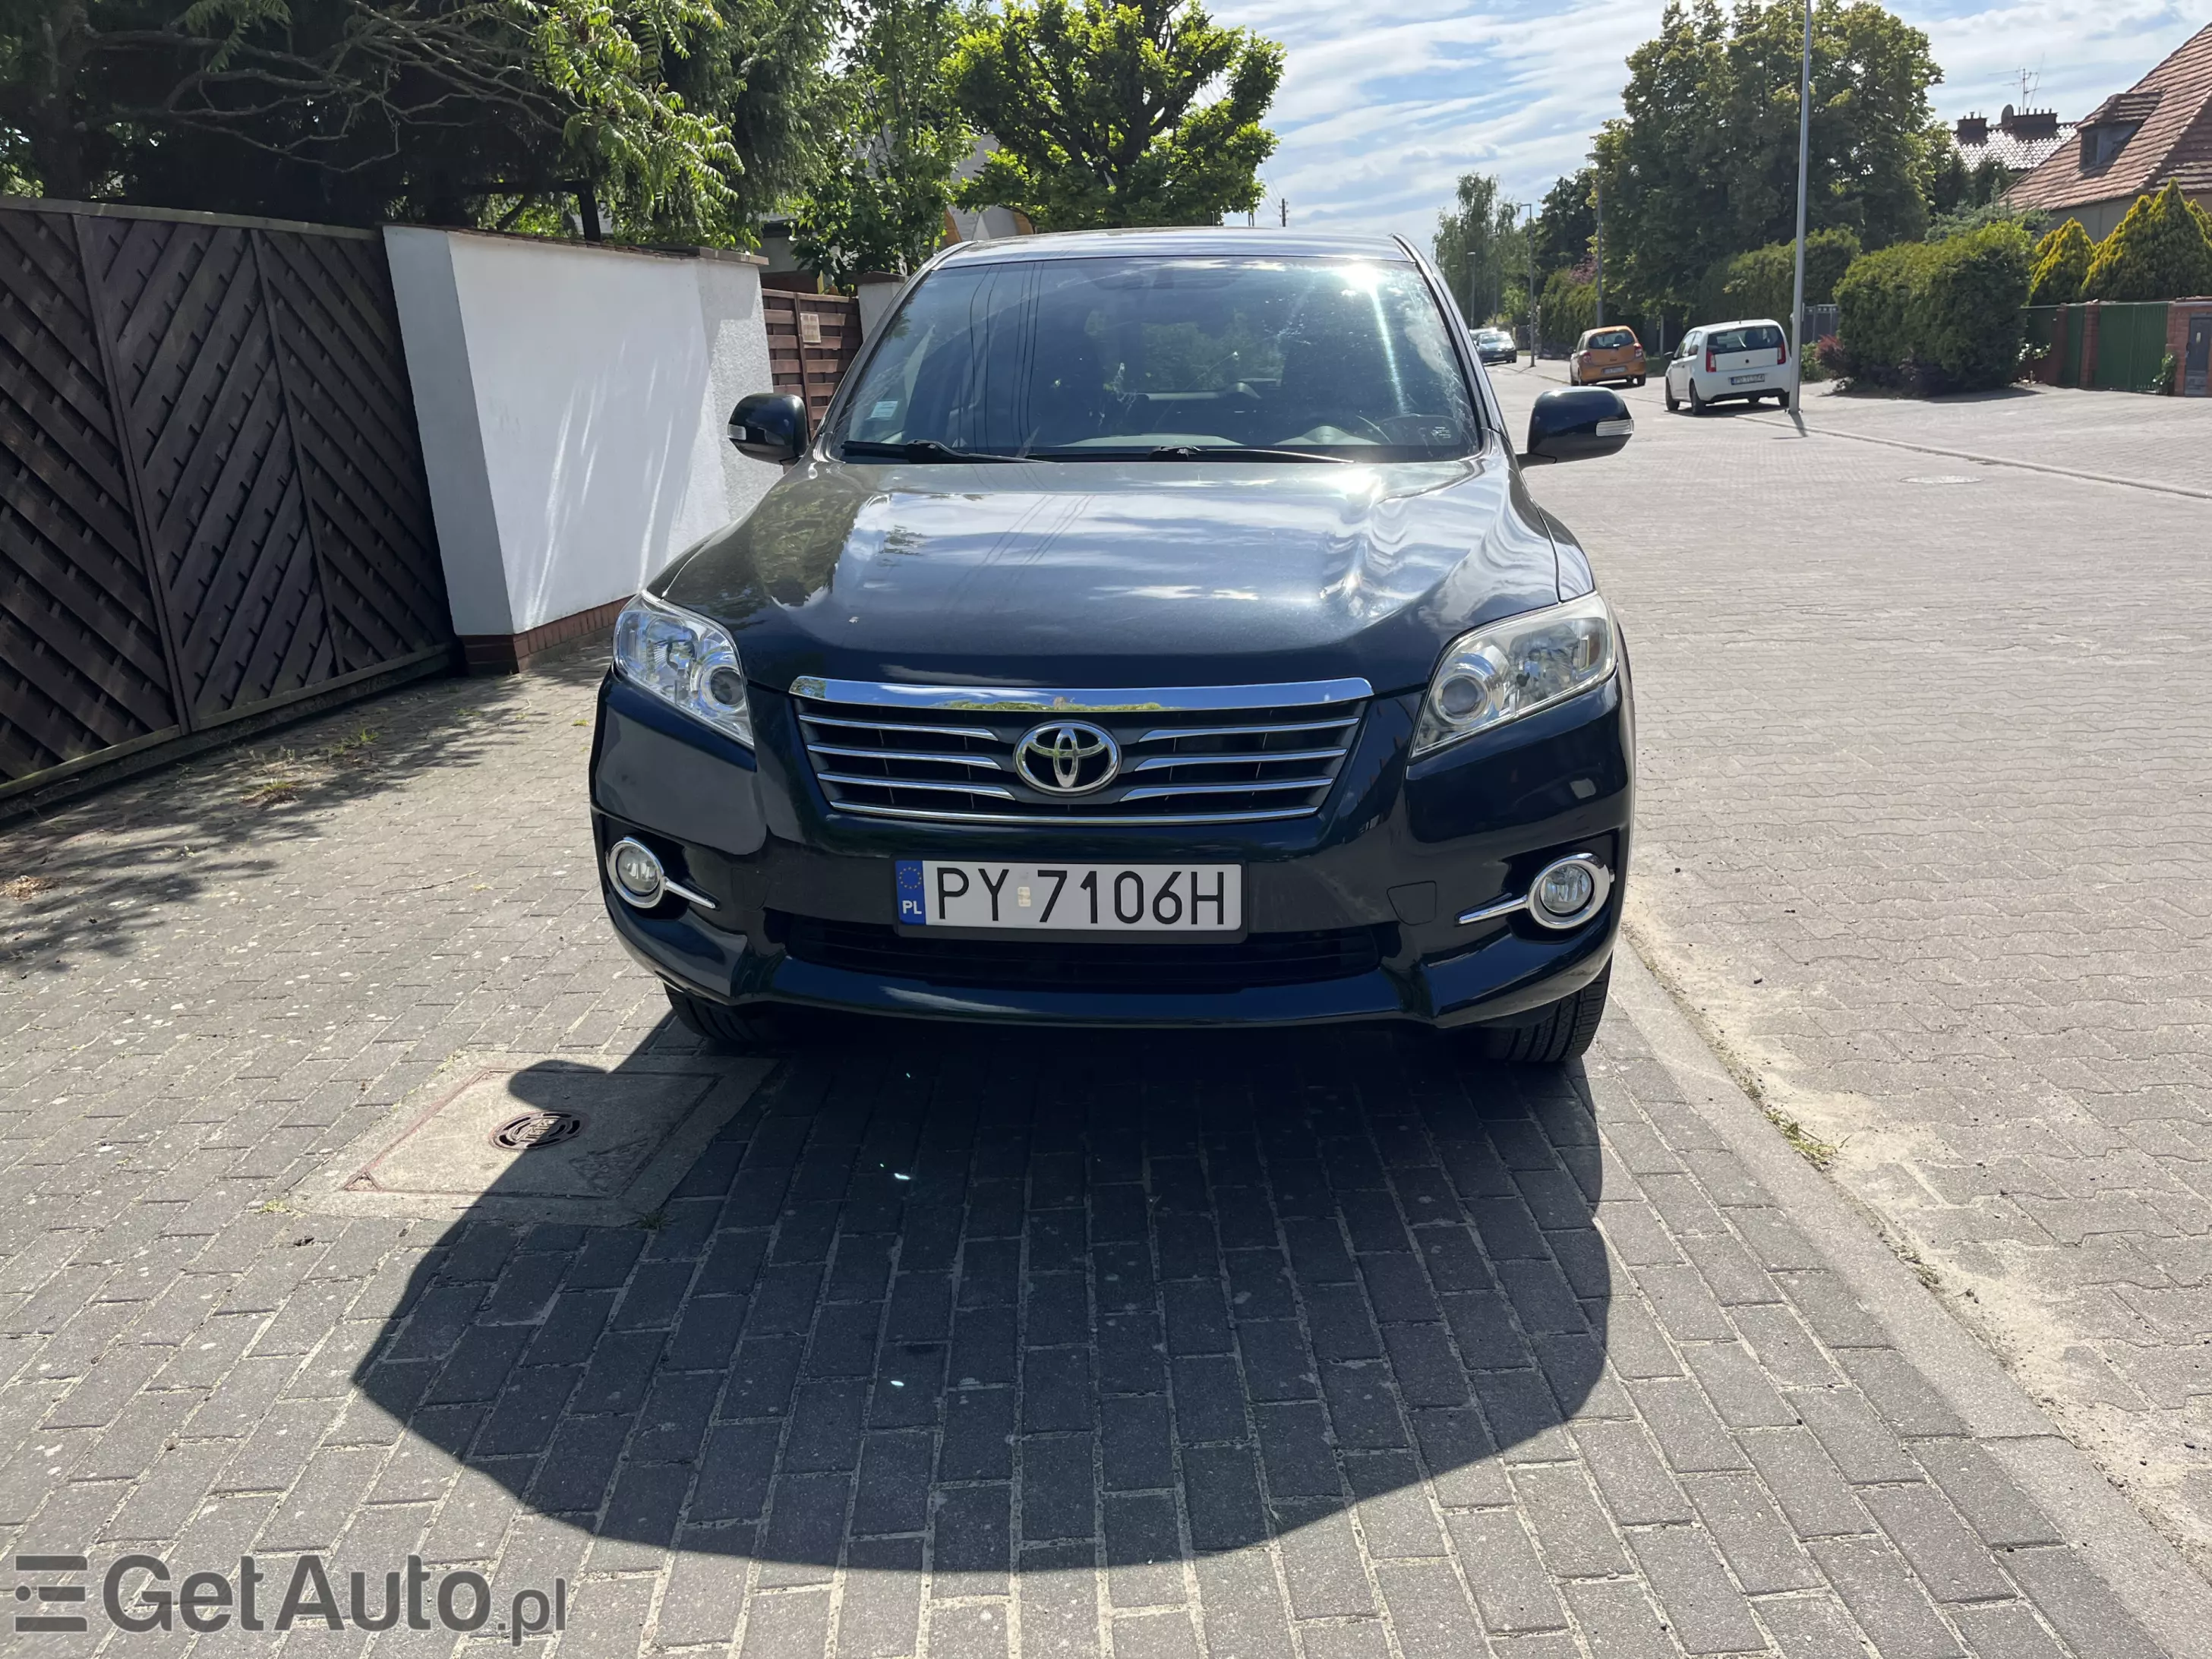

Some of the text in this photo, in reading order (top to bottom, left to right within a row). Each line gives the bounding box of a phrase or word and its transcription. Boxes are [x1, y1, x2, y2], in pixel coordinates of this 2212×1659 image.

[902, 900, 923, 915] PL
[936, 866, 1225, 926] PY 7106H
